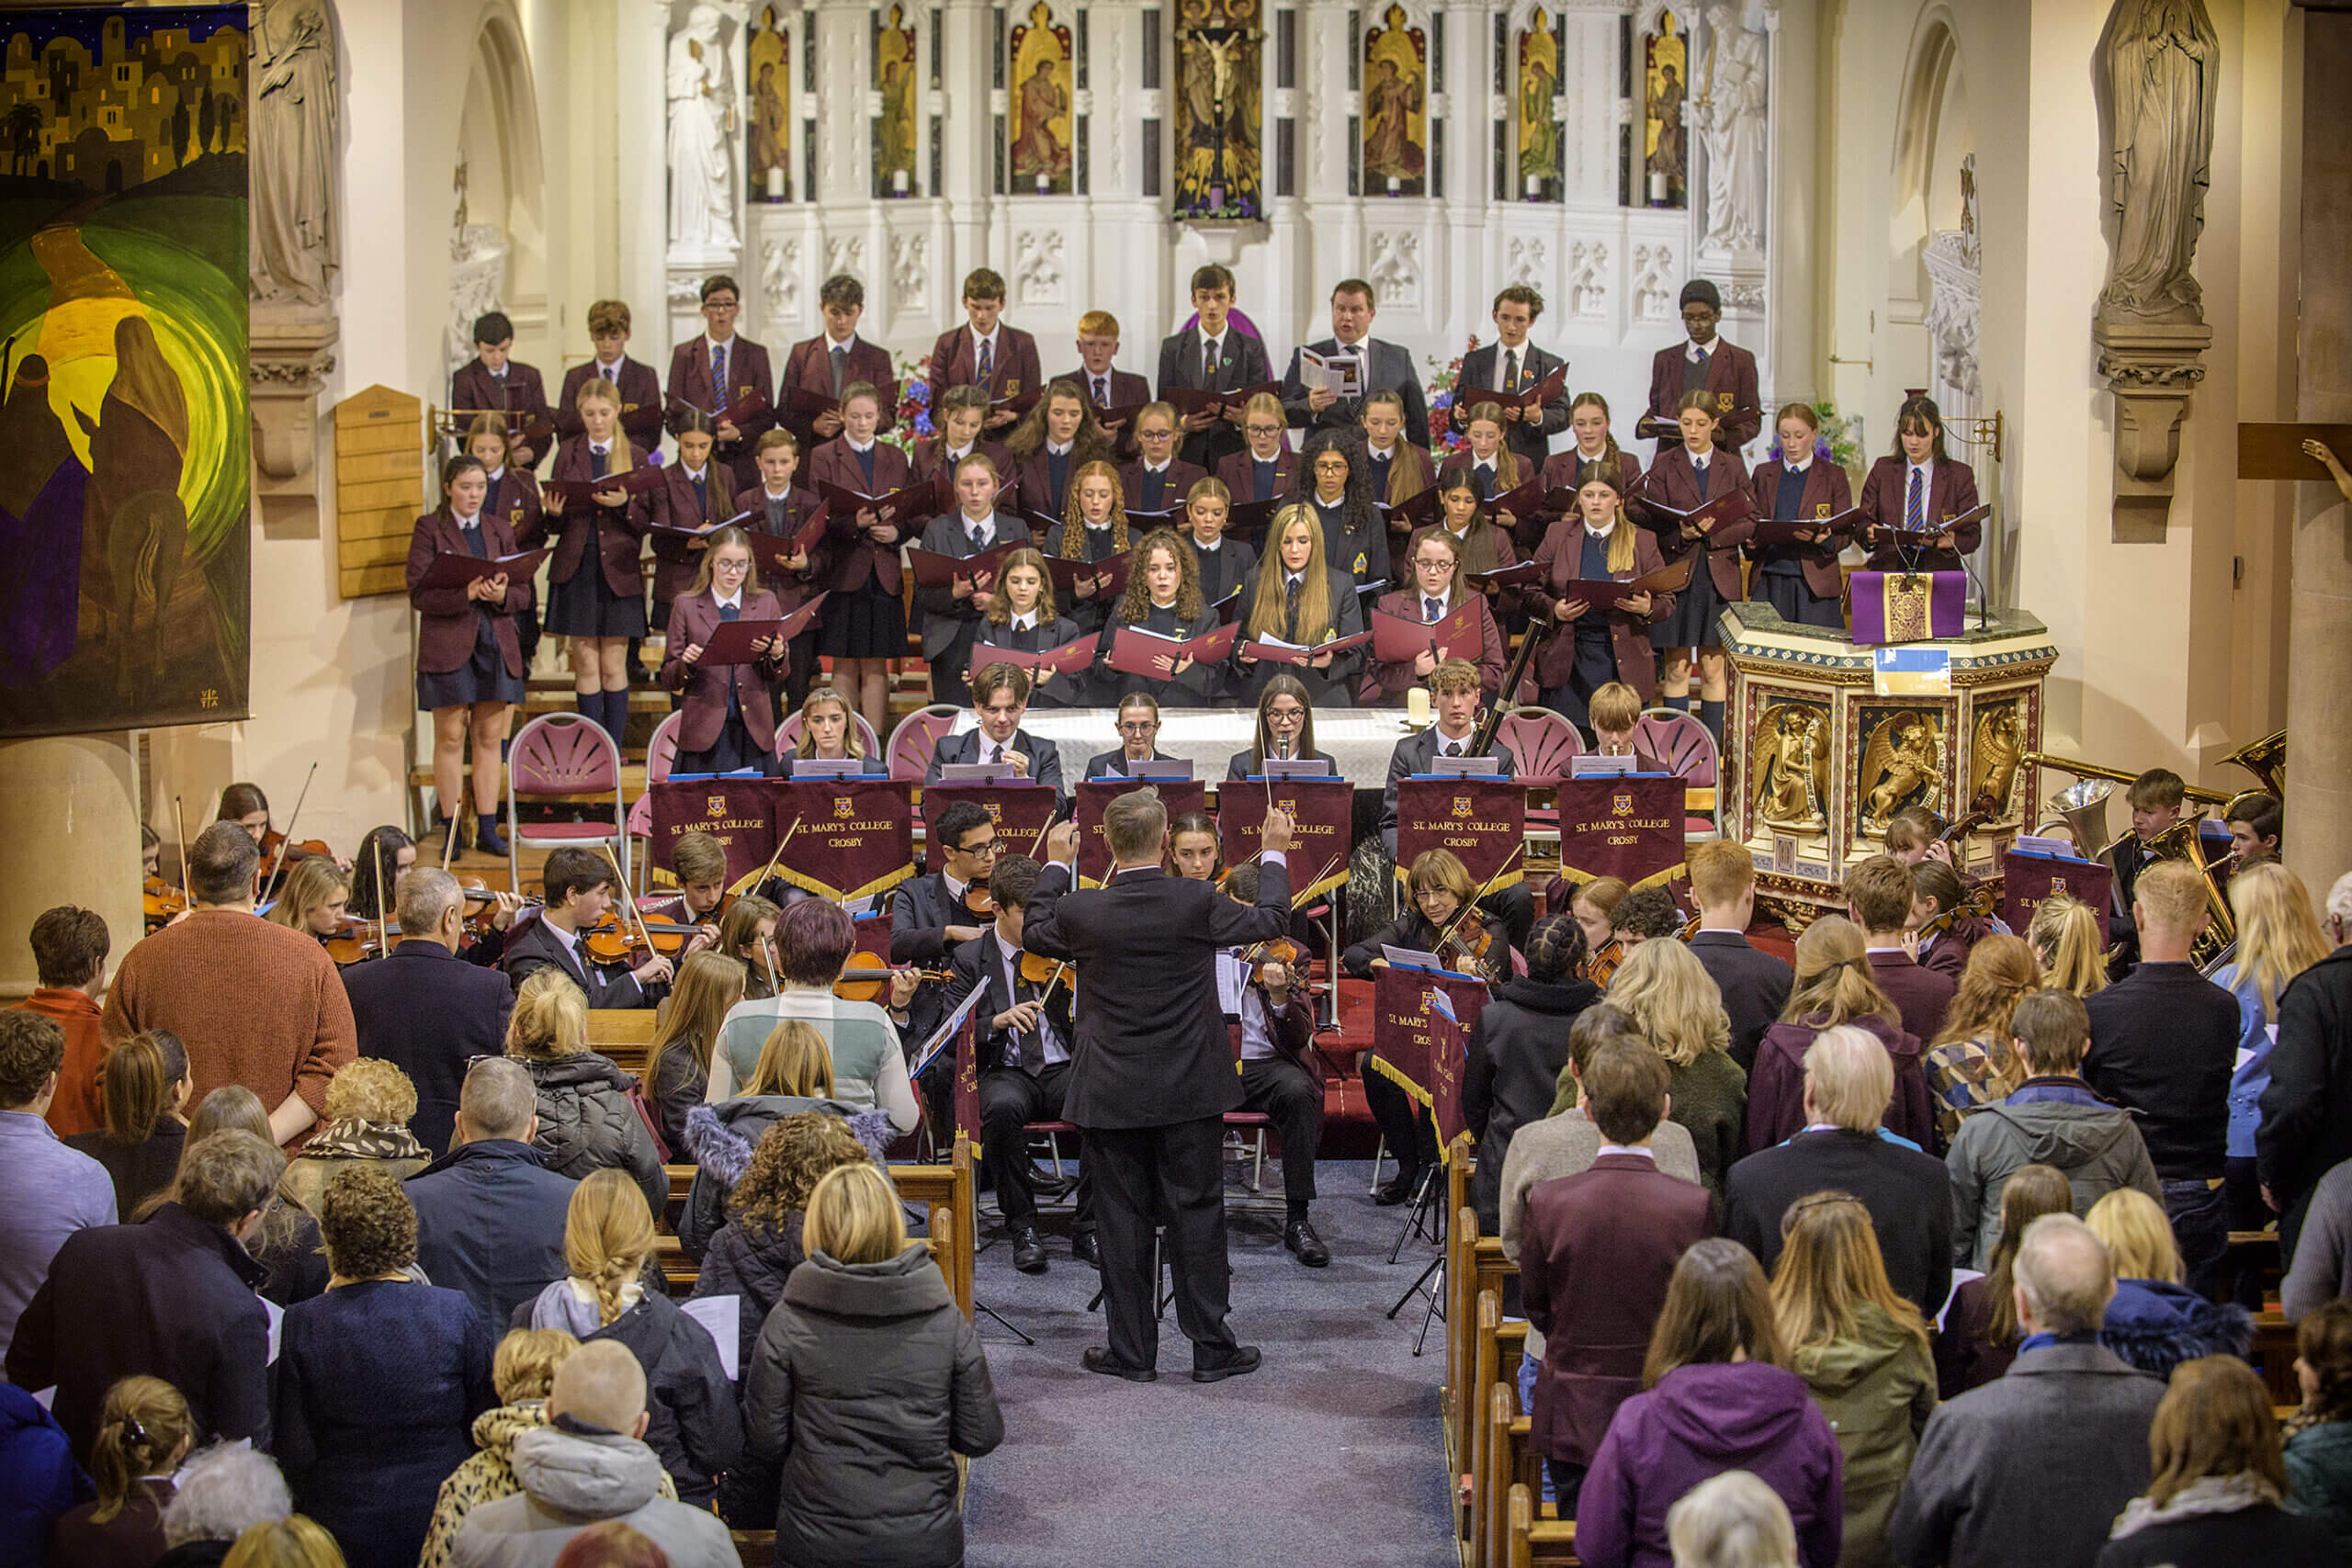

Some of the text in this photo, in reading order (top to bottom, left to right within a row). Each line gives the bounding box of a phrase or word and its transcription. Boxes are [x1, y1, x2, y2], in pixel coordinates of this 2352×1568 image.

[684, 821, 720, 832] MARY'S
[722, 819, 764, 829] COLLEGE
[797, 820, 893, 833] ST. MARY'S COLLEGE
[1413, 821, 1510, 831] ST. MARY'S COLLEGE
[1576, 819, 1670, 832] ST. MARY'S COLLEGE
[997, 828, 1040, 838] COLLEGE
[829, 837, 862, 847] CROSBY
[1444, 837, 1478, 847] CROSBY
[1608, 836, 1639, 845] CROSBY
[1398, 1016, 1428, 1029] MARY'S
[1413, 1033, 1431, 1045] CROS
